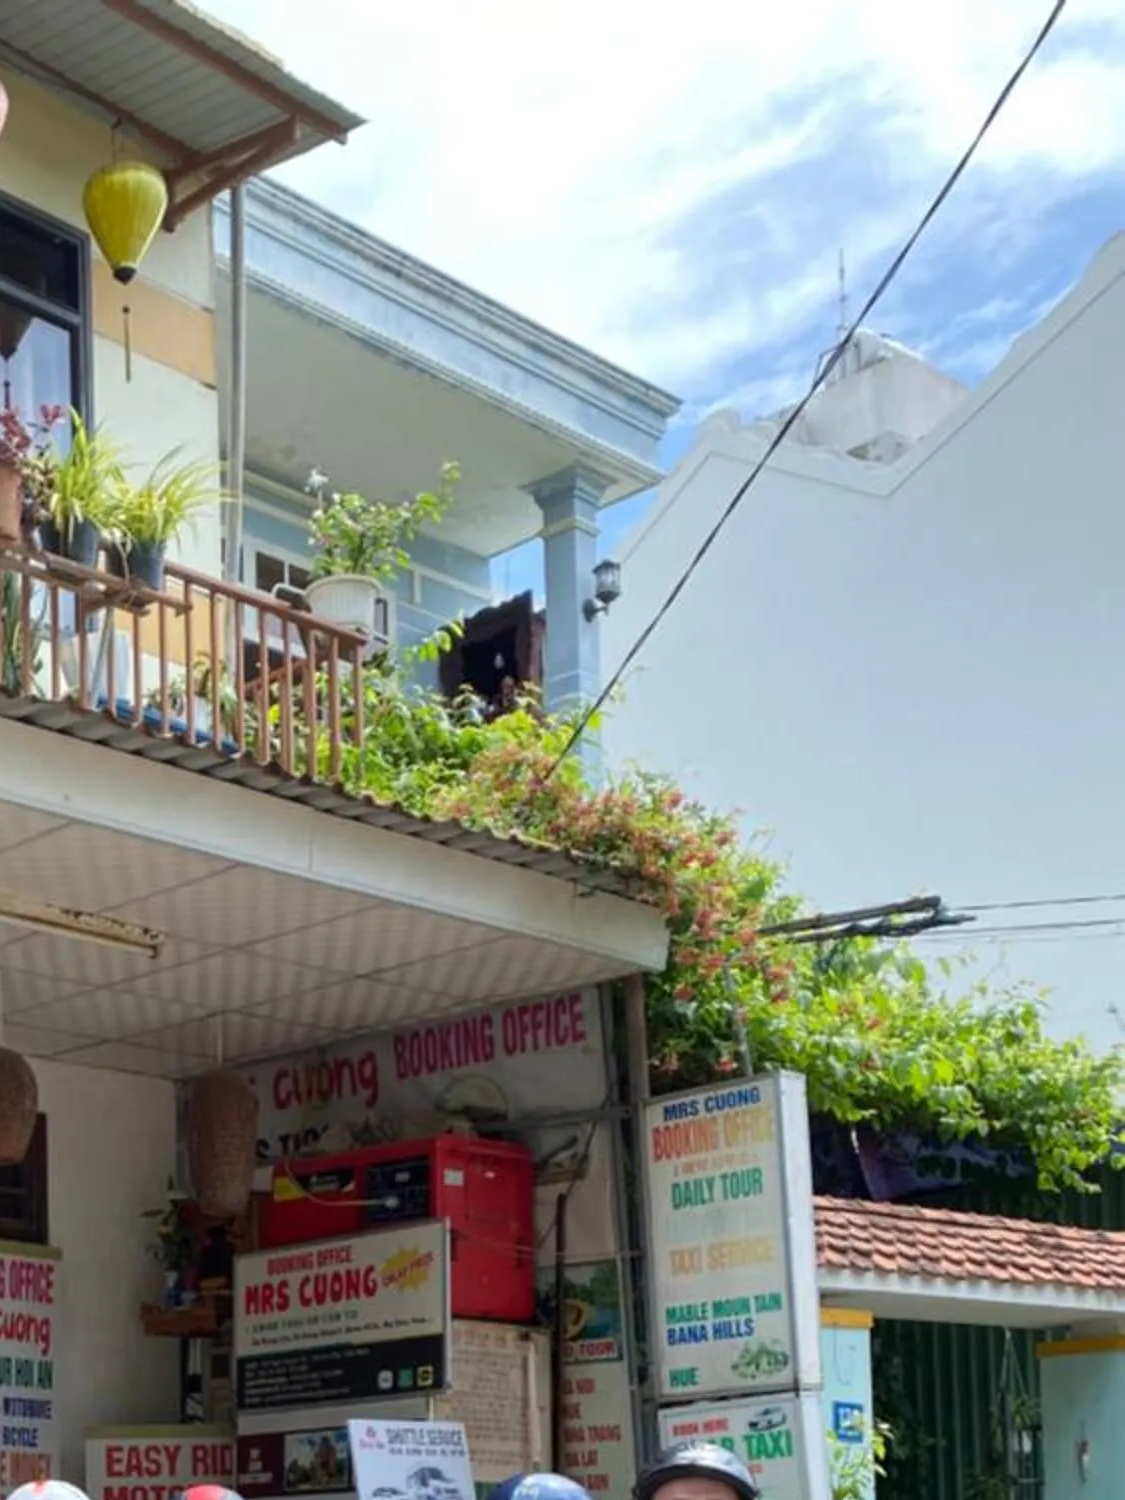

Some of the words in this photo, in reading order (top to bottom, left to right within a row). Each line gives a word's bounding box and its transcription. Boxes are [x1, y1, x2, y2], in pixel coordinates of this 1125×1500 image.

[392, 1010, 495, 1080] BOOKING
[501, 992, 587, 1058] OFFICE
[663, 1099, 700, 1121] MRS
[704, 1086, 761, 1113] CUONG
[652, 1115, 719, 1162] BOOKING
[671, 1175, 716, 1211] DAILY
[719, 1167, 764, 1200] TOUR
[317, 1245, 353, 1268] OFFICE
[9, 1259, 54, 1305] OFFICE
[244, 1279, 290, 1316] MRS
[299, 1263, 379, 1308] CUONG
[667, 1324, 709, 1346] BANA
[711, 1317, 755, 1341] HILLS
[668, 1366, 700, 1388] HUE
[105, 1444, 182, 1478] EASY
[191, 1443, 234, 1478] RID
[744, 1429, 794, 1461] TAXI
